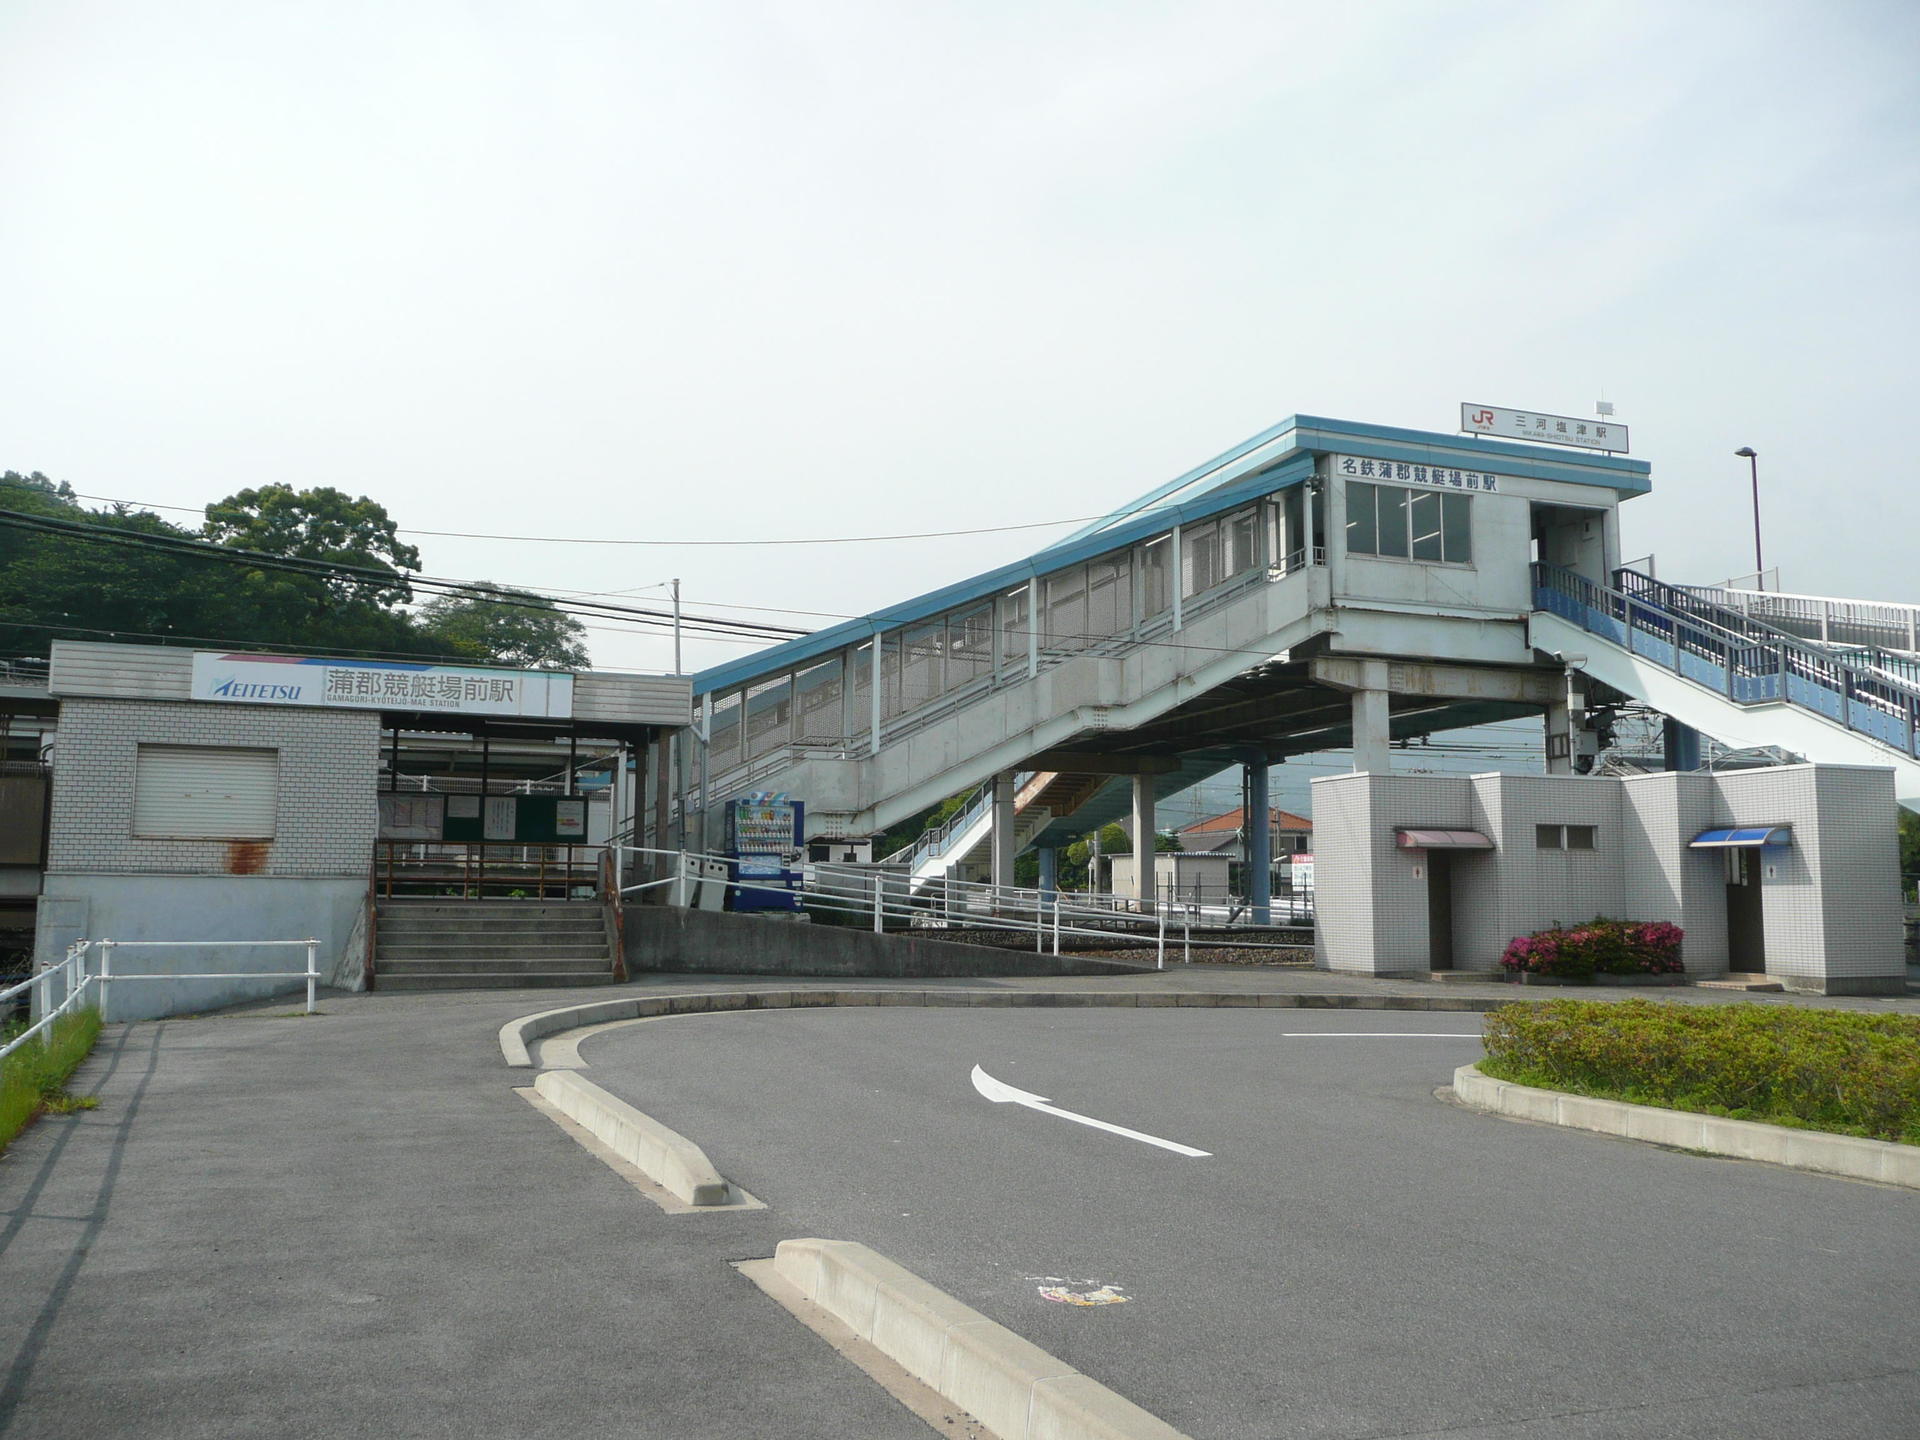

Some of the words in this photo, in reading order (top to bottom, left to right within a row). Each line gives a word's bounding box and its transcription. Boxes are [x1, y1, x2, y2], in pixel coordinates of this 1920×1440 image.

[1472, 410, 1494, 425] JR
[1515, 415, 1607, 439] 三河塩津駅
[1575, 436, 1601, 446] STATION
[1342, 458, 1497, 491] 名鉄蒲郡競艇場前駅
[208, 673, 302, 700] MEITETSU
[327, 668, 514, 703] 蒲郡競艇場前駅
[430, 699, 460, 708] STATION
